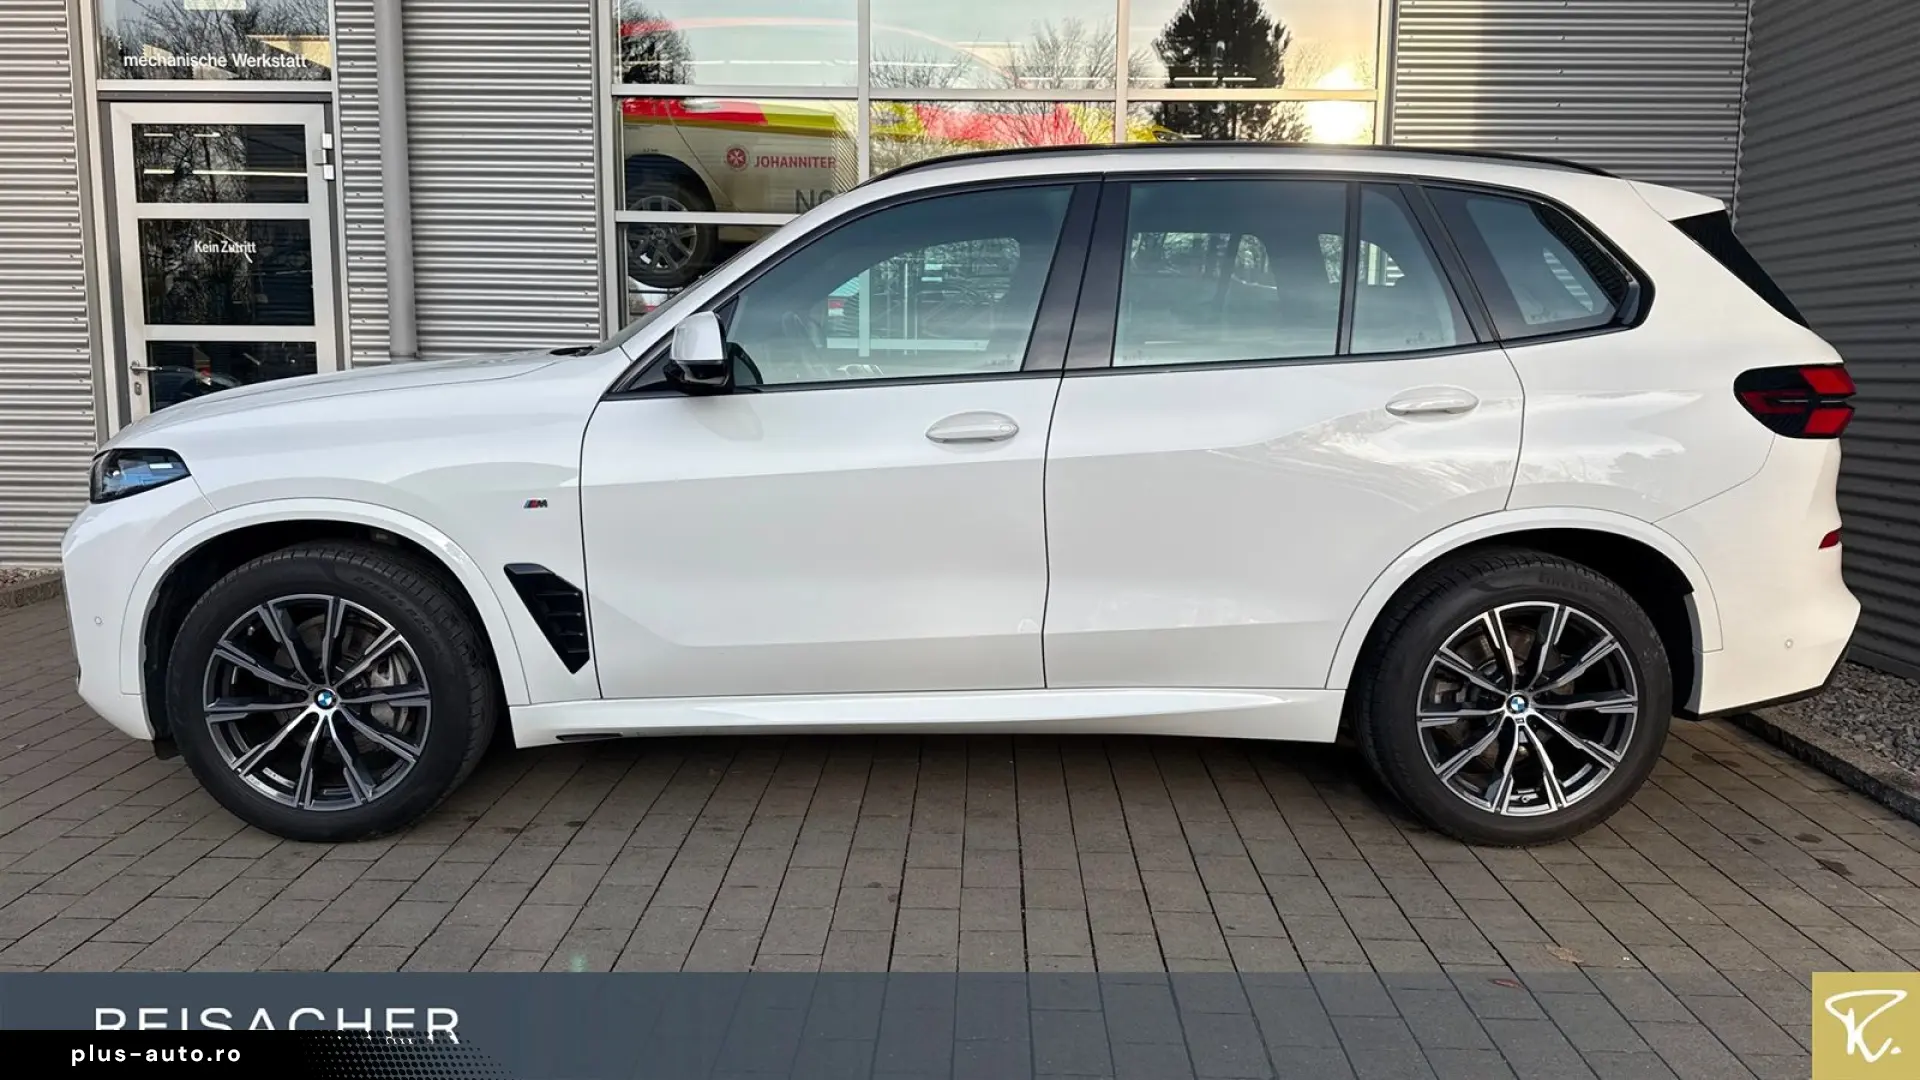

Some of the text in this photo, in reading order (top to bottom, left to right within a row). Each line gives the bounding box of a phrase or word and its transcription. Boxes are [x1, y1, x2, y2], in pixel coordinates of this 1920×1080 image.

[124, 53, 307, 68] mechanische Werkstatt
[755, 156, 837, 168] JOHANNITER
[194, 240, 257, 253] Kein Zutritt
